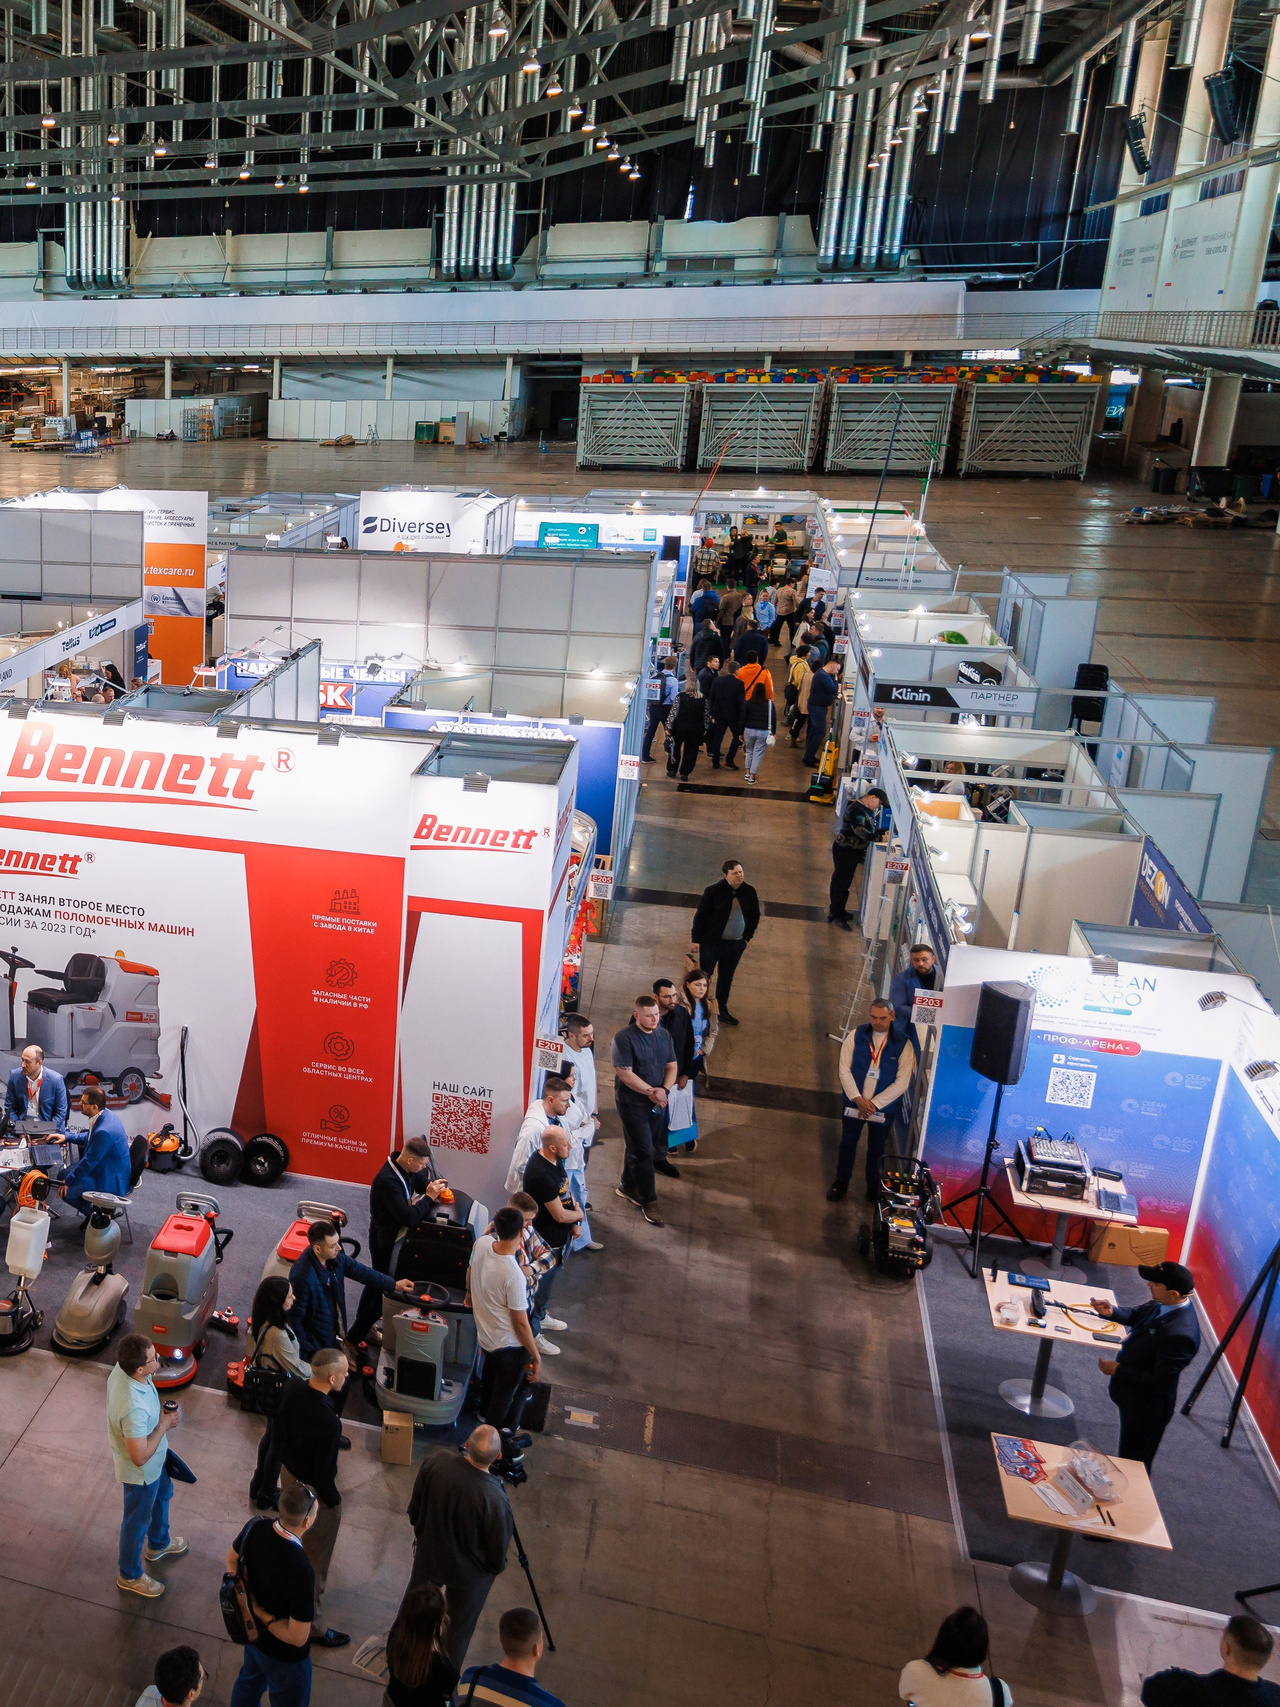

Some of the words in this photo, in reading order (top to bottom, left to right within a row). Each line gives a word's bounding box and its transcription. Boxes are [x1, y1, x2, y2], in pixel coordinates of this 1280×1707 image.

[380, 518, 451, 537] Diversey
[891, 687, 931, 702] Klinin
[970, 691, 1019, 702] ПАРТНЁР
[6, 720, 266, 801] Bennett
[413, 812, 539, 851] Bennett
[886, 861, 908, 870] E207
[592, 875, 613, 884] E205
[18, 892, 56, 907] ЗАНЯЛ
[58, 895, 103, 912] ВТОРОЕ
[105, 900, 146, 917] МЕСТО
[23, 918, 38, 929] ЗА
[40, 921, 67, 935] 2023
[54, 909, 145, 931] ПОЛОМОЕЧНЫХ
[148, 922, 195, 938] МАШИН
[311, 914, 341, 923] ПРЯМЫЕ
[341, 917, 378, 928] ПОСТАВКИ
[319, 922, 347, 931] ЗАВОДА
[353, 926, 375, 935] КИТАЕ
[311, 989, 348, 999] ЗАПАСНЫЕ
[348, 994, 371, 1003] ЧАСТИ
[319, 997, 352, 1007] НАЛИЧИИ
[914, 997, 942, 1008] E203
[536, 1039, 562, 1052] E201
[1042, 1032, 1125, 1052] ПРОФ-АРЕНА
[302, 1066, 342, 1078] ОБЛАСТНЫХ
[343, 1073, 373, 1083] ЦЕНТРАХ
[311, 1061, 337, 1071] СЕРВИС
[347, 1067, 365, 1075] ВСЕХ
[432, 1080, 460, 1094] НАШ
[462, 1082, 494, 1098] САЙТ
[302, 1131, 338, 1143] ОТЛИЧНЫЕ
[338, 1137, 358, 1145] ЦЕНЫ
[301, 1137, 368, 1154] ПРЕМИУМ-КАЧЕСТВО
